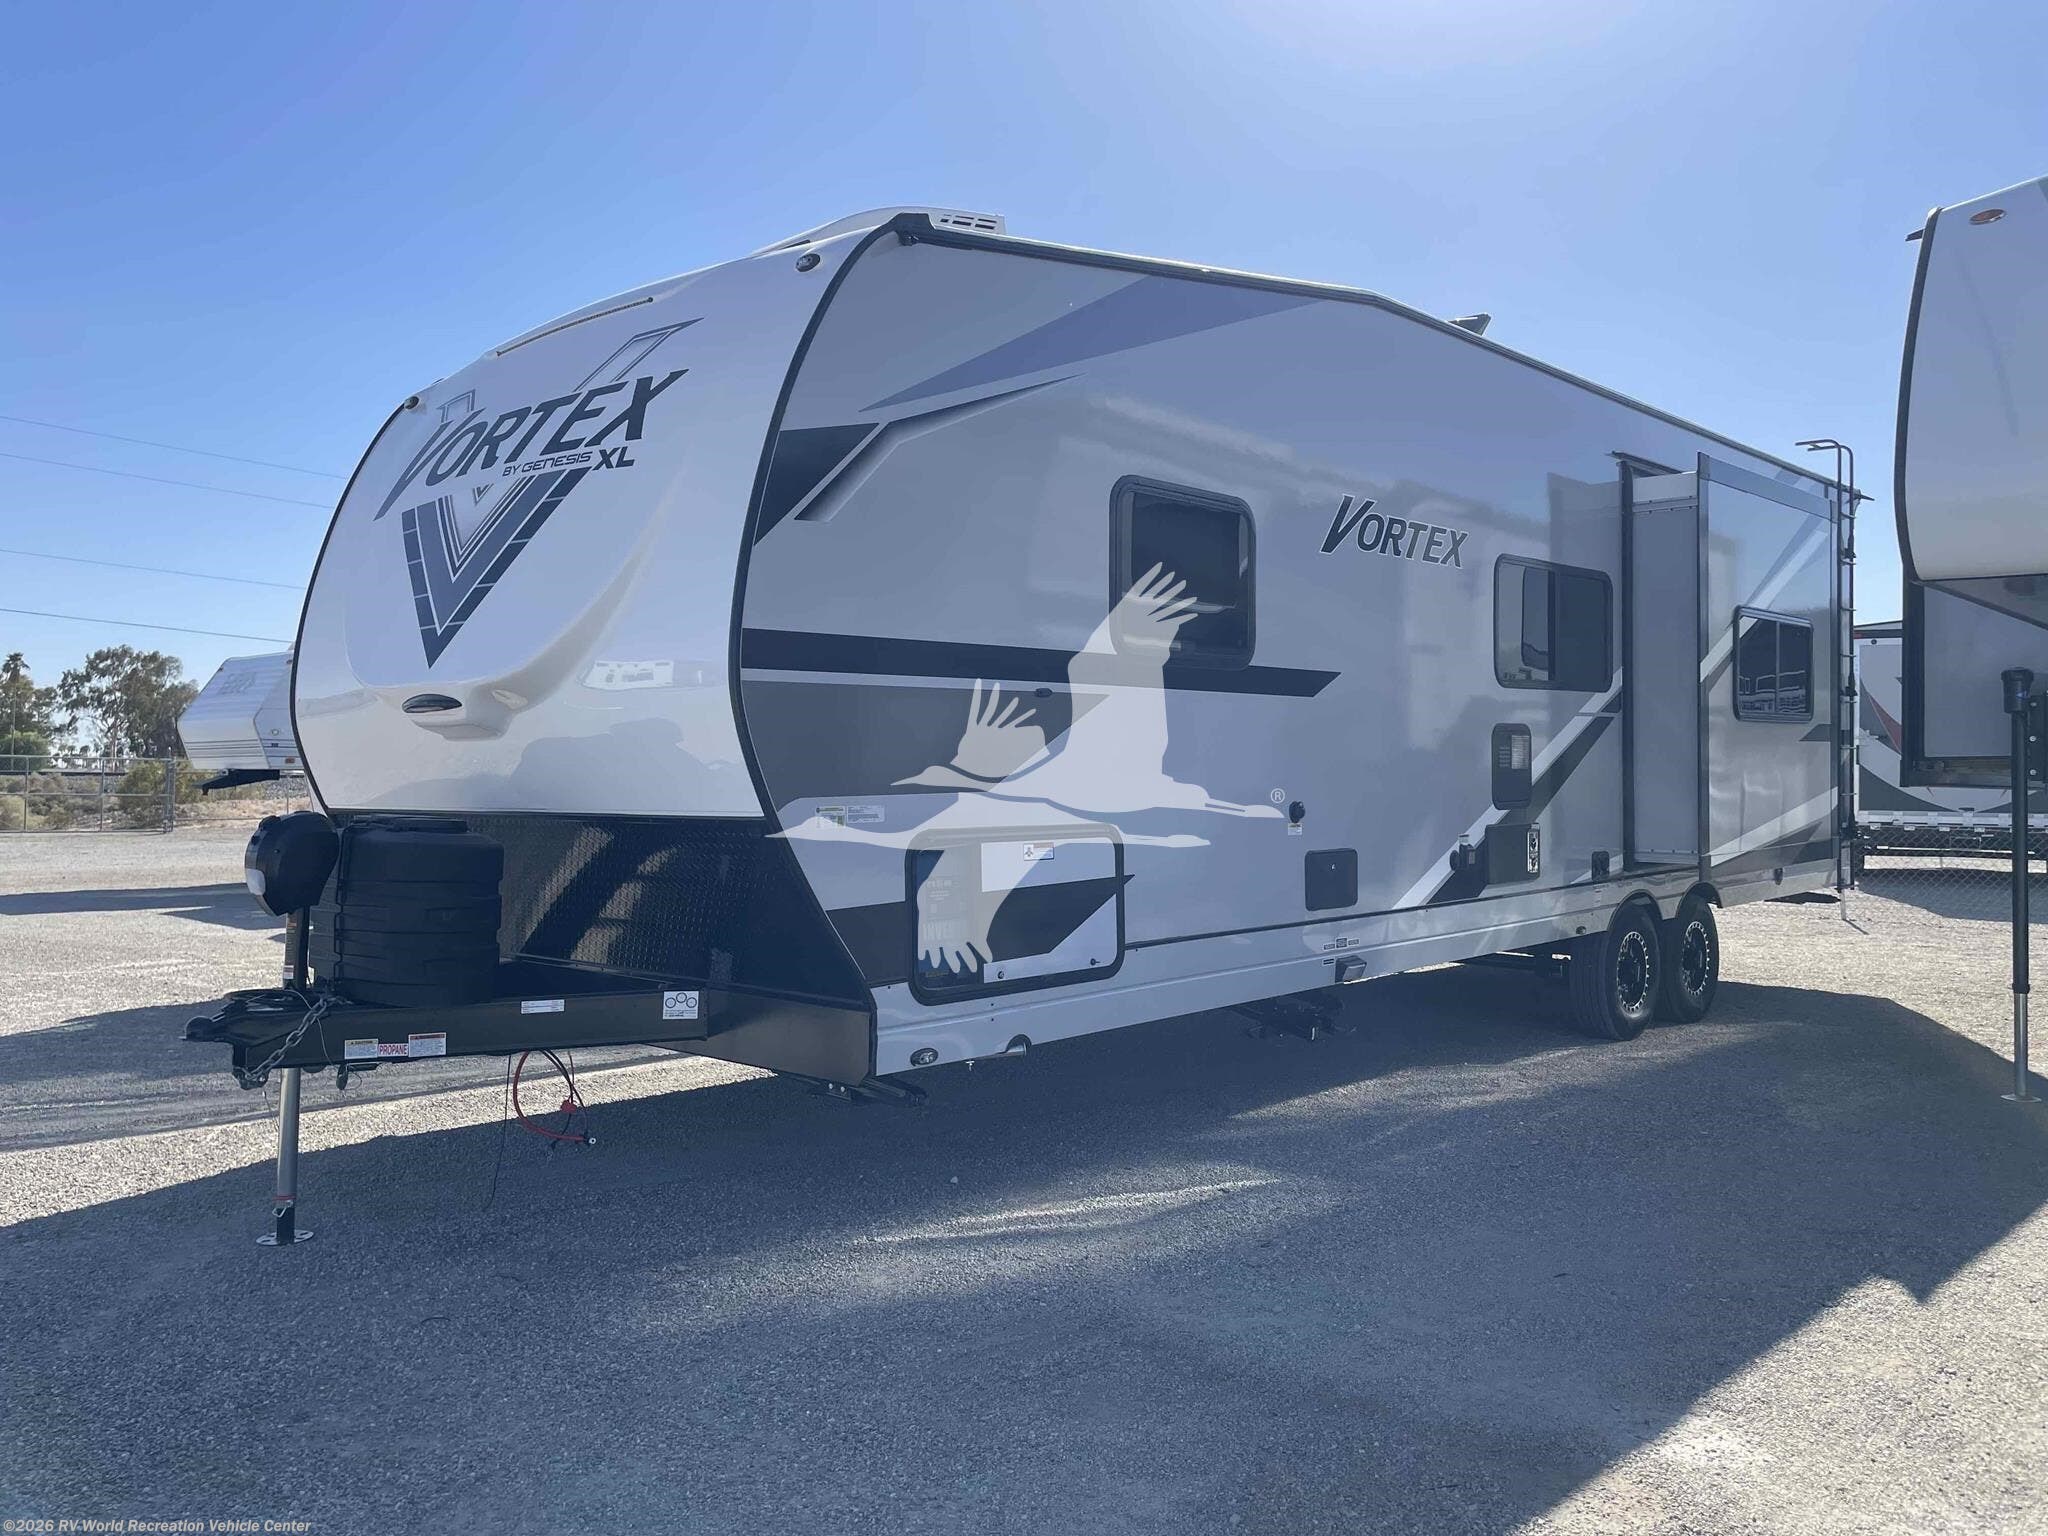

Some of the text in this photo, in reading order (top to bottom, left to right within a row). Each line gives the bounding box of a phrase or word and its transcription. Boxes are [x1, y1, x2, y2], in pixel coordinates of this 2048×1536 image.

[373, 369, 690, 521] VORTEX
[502, 446, 636, 477] BY GENESIS XL
[1319, 493, 1469, 569] VORTEX
[379, 1044, 408, 1055] PROPANE
